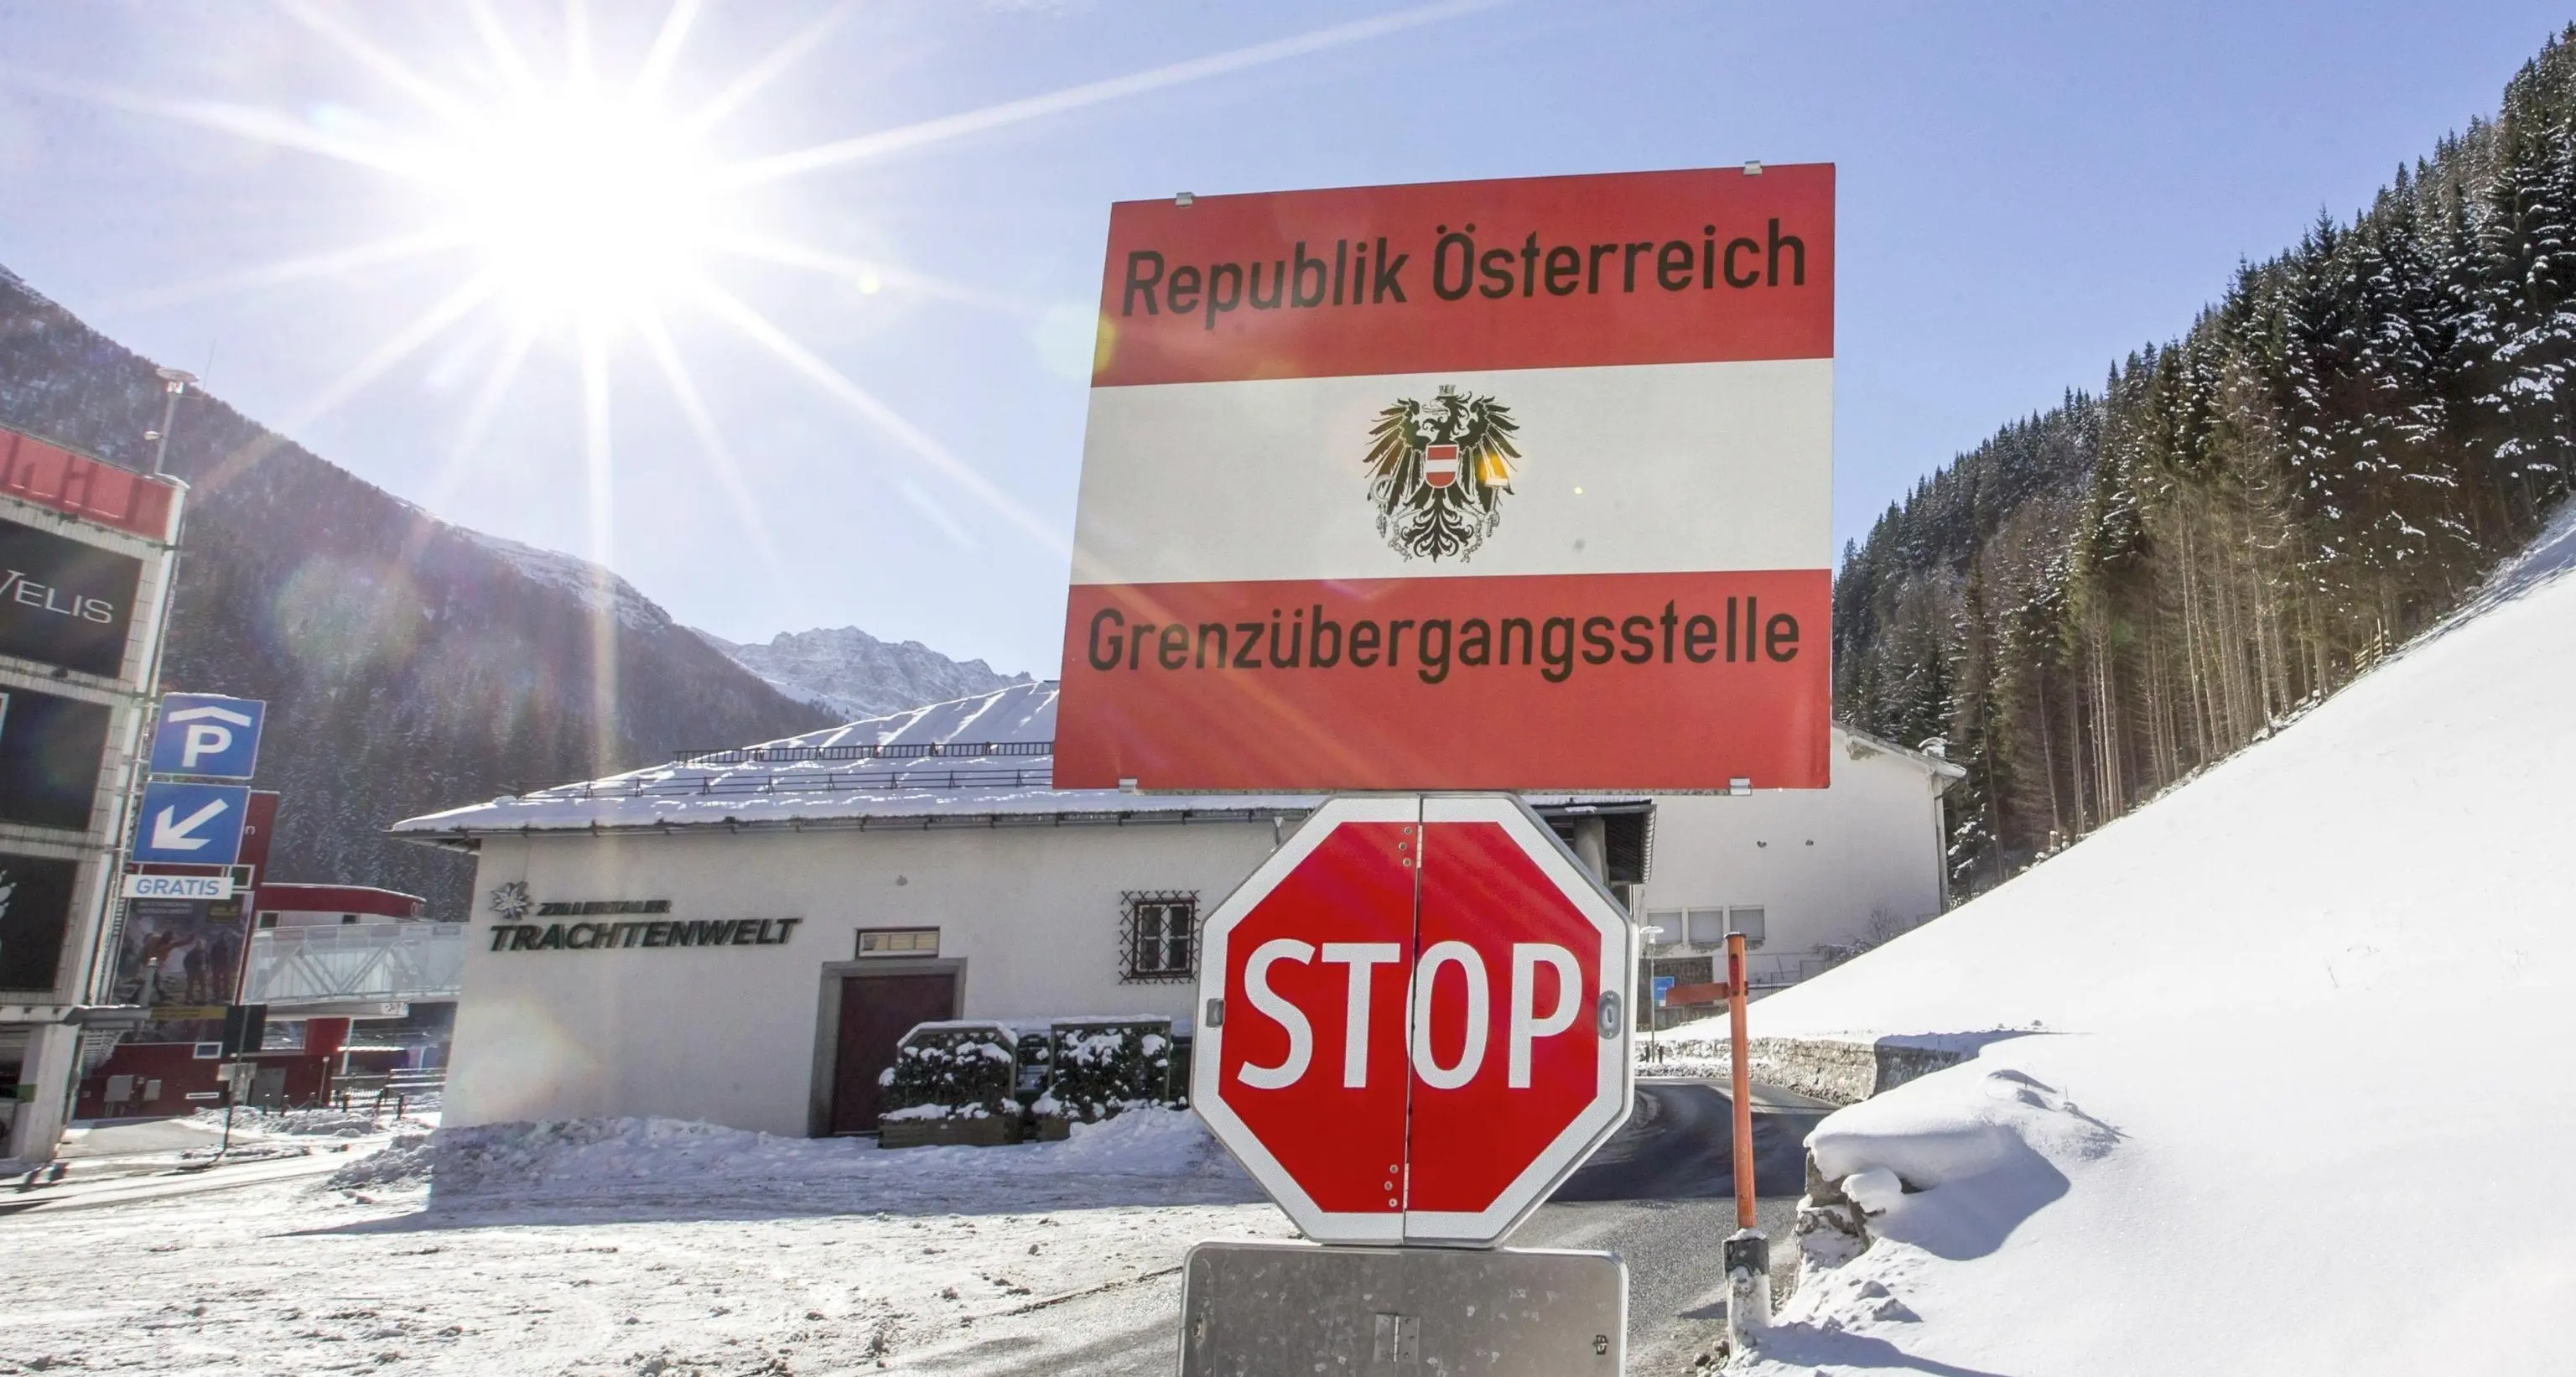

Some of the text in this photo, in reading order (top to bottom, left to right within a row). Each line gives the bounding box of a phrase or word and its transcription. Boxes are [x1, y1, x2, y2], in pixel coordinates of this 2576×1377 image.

[1122, 217, 1805, 330] Republik Österreich
[1088, 595, 1800, 685] Grenzübergangsstelle
[182, 724, 232, 767] P
[136, 878, 220, 896] GRATIS
[490, 917, 803, 952] TRACHTENWELT
[1237, 938, 1582, 1089] STOP
